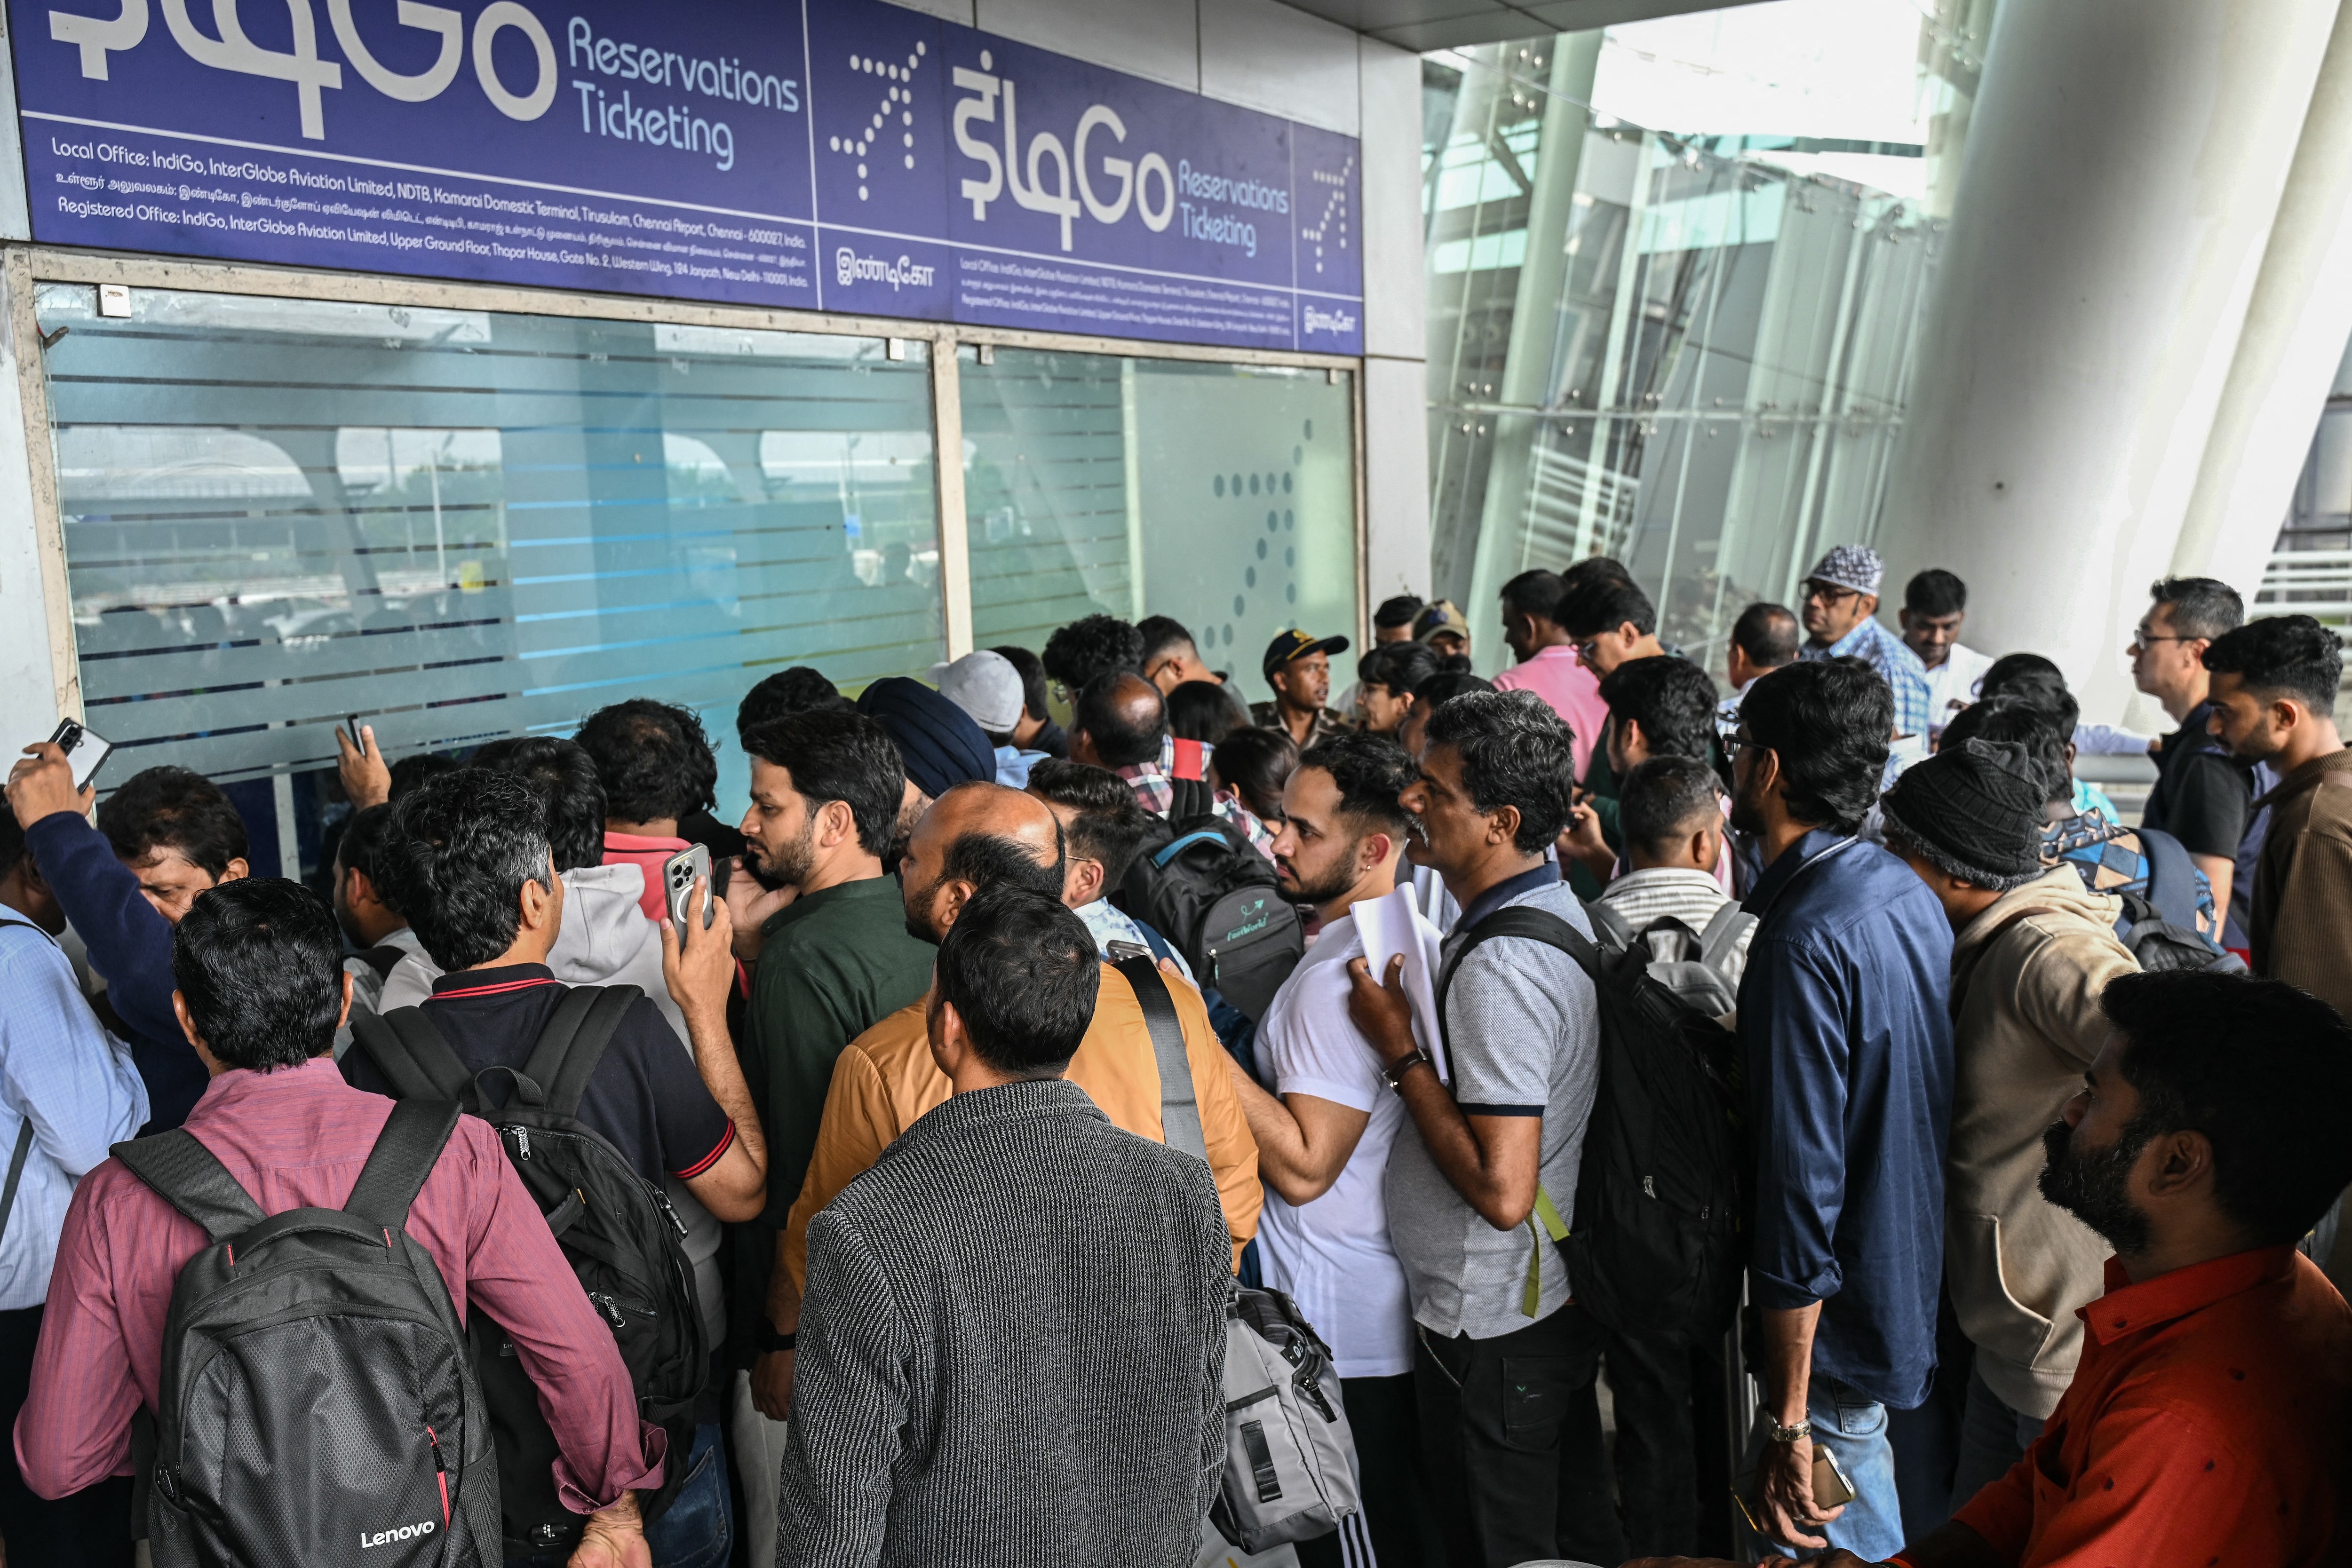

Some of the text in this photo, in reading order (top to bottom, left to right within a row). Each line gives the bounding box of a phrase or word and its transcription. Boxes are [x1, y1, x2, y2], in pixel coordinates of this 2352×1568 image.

[568, 16, 799, 113] Reservations
[572, 79, 735, 172] Ticketing
[52, 136, 94, 159] Local
[97, 143, 150, 166] Office:
[152, 150, 207, 176] IndiGo,
[209, 157, 287, 184] InterGlobe
[289, 167, 346, 191] Aviation
[347, 175, 396, 199] Limited,
[397, 182, 433, 204] NDTB,
[484, 193, 535, 214] Domestic
[535, 199, 581, 222] Terminal,
[1178, 159, 1289, 214] Reservations
[58, 195, 134, 219] Registered
[135, 204, 181, 223] Office:
[182, 209, 228, 230] IndiGo,
[229, 214, 296, 236] InterGlobe
[297, 221, 346, 241] Aviation
[347, 227, 389, 246] Limited,
[389, 231, 423, 251] Upper
[424, 235, 465, 253] Ground
[1179, 201, 1256, 258] Ticketing
[836, 247, 935, 292] இண்டிகோ
[361, 1521, 435, 1548] Lenovo
